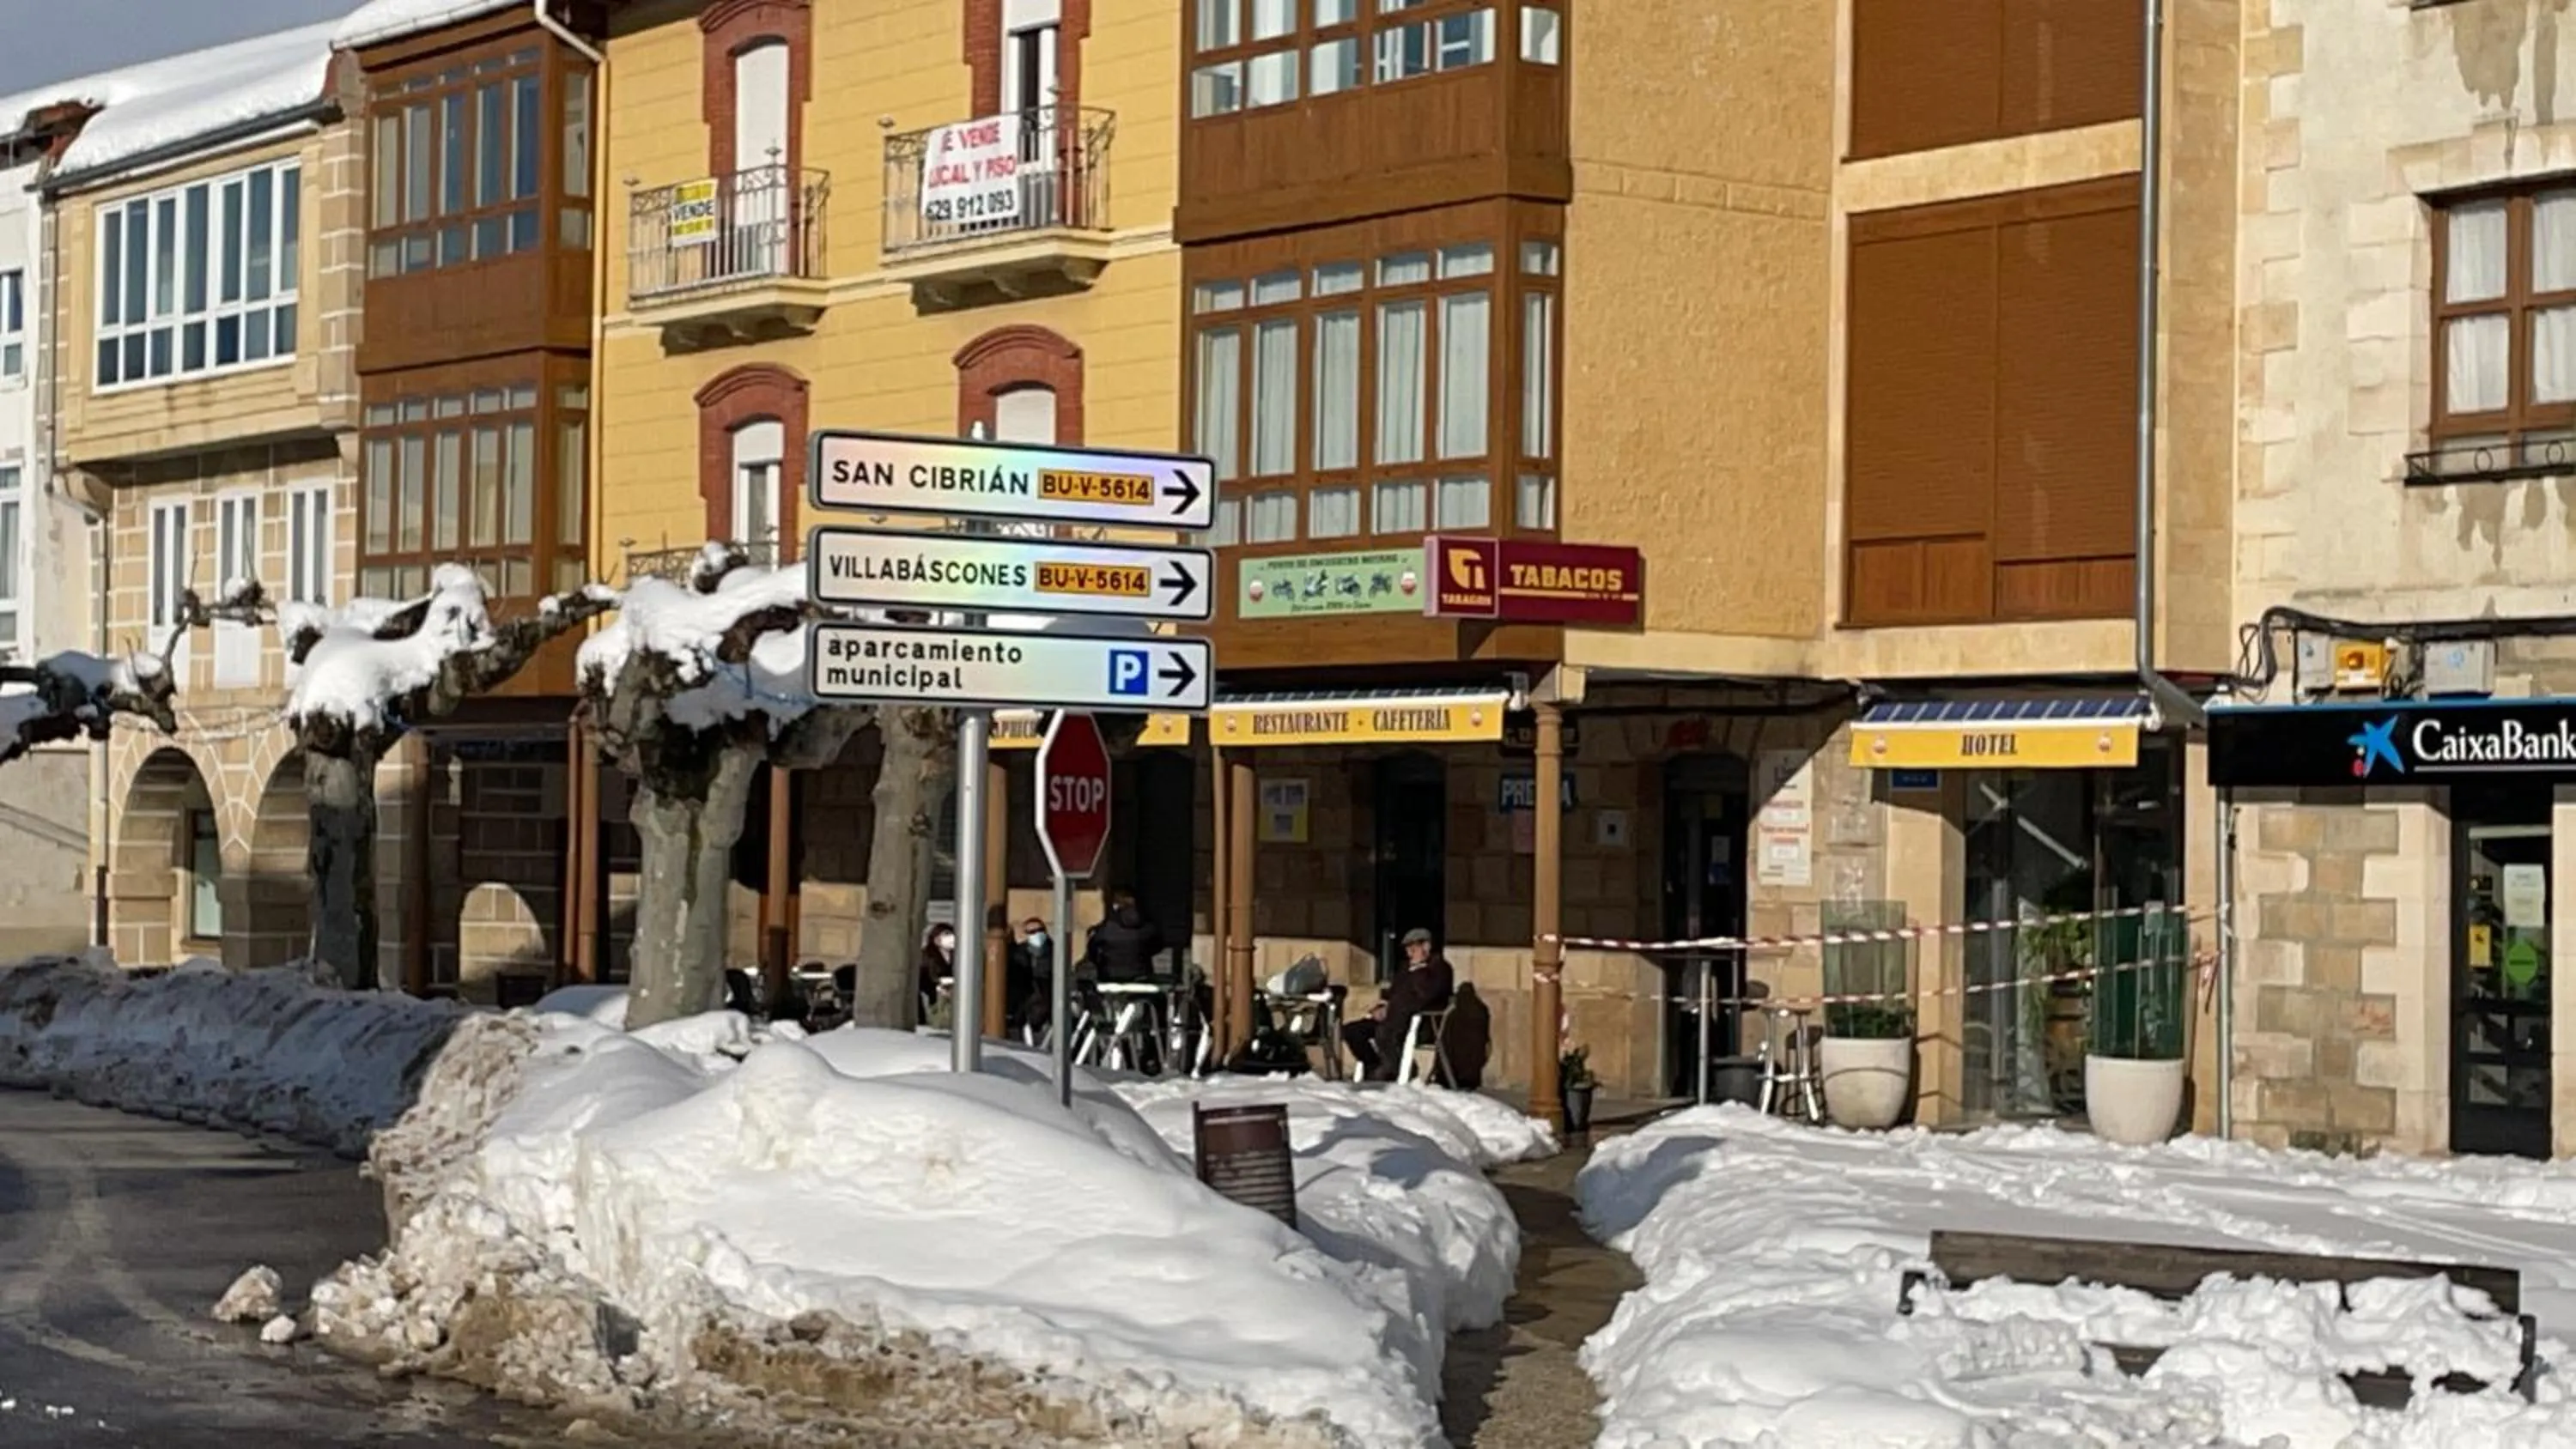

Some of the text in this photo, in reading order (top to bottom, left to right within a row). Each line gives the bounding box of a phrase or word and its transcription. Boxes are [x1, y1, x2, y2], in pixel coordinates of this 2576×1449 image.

[972, 160, 982, 182] Y
[673, 198, 715, 222] VENDE
[957, 193, 984, 219] 912
[987, 188, 1015, 214] 093
[832, 459, 1150, 500] SAN CIBRIÁN BU-V-5614
[829, 554, 1146, 591] VILLABÁSCONES BU-V-5614
[1509, 564, 1622, 591] TABACOS
[826, 665, 963, 692] municipal
[827, 639, 1142, 692] aparcamiento P
[1253, 707, 1451, 735] RESTAURANTE CAFETERÍA
[1961, 733, 2017, 756] HOTEL
[2412, 718, 2576, 761] CaixaBank
[1049, 775, 1105, 813] STOP
[1501, 778, 1573, 806] PREA
